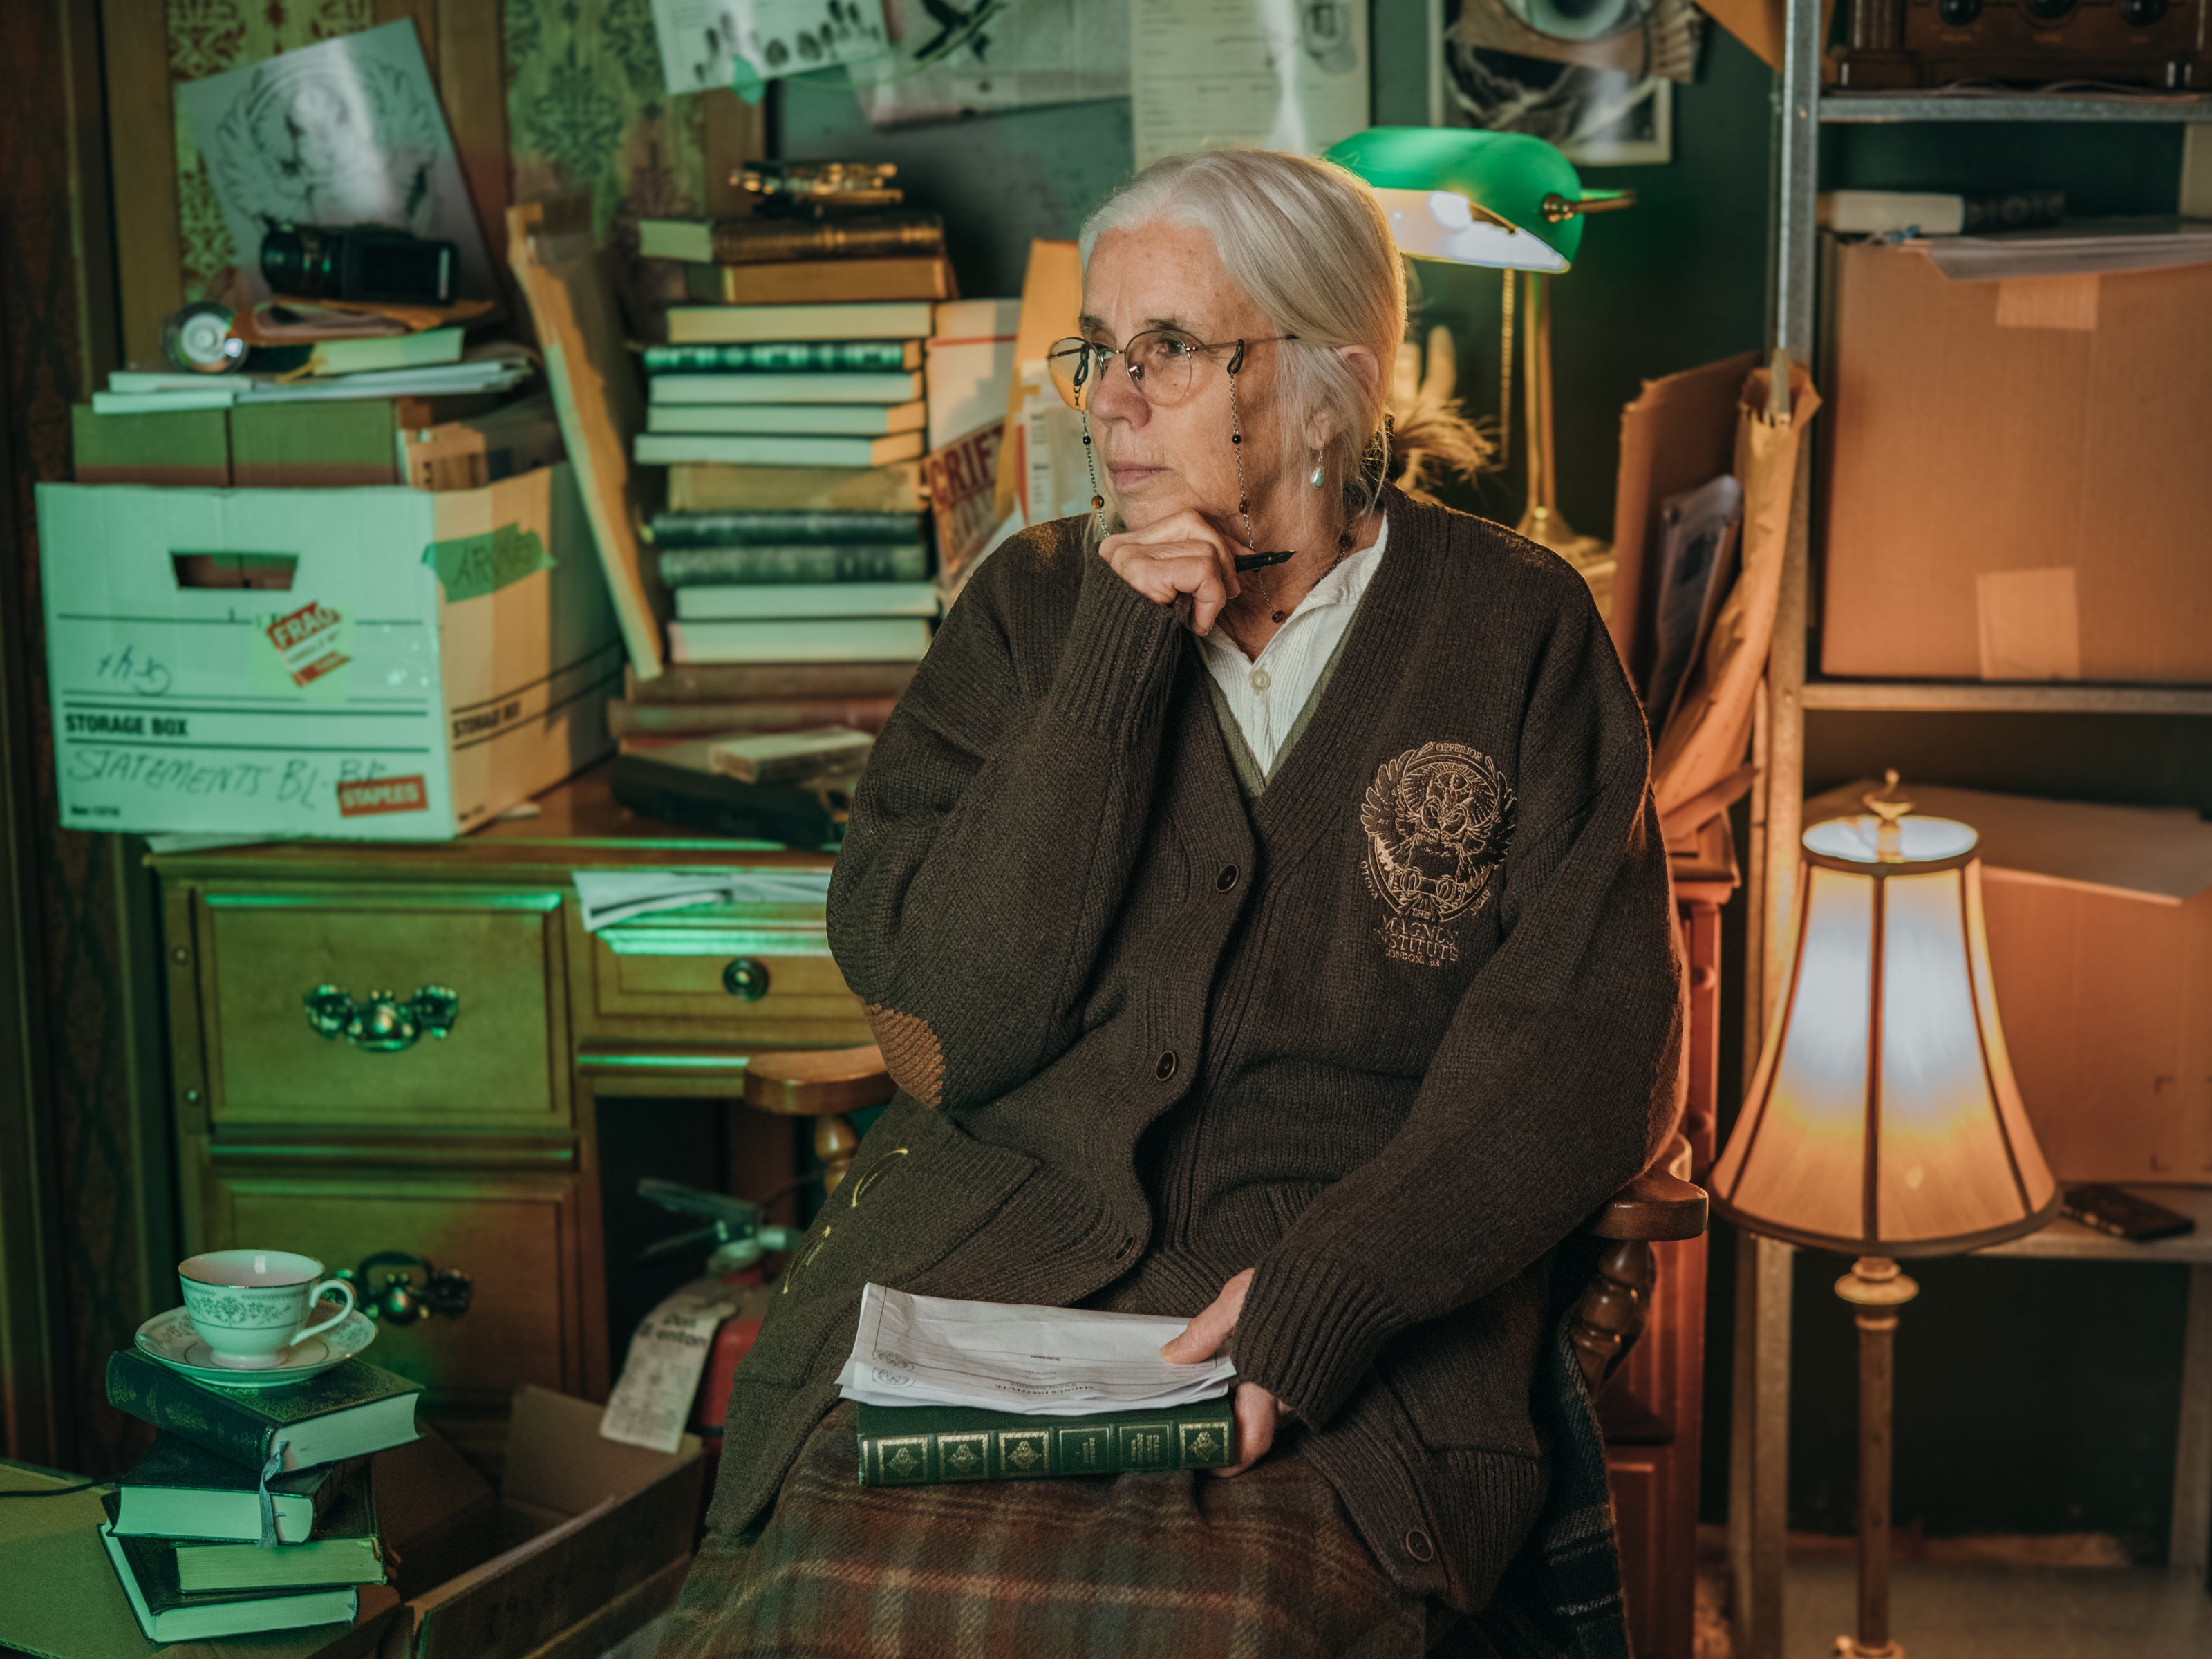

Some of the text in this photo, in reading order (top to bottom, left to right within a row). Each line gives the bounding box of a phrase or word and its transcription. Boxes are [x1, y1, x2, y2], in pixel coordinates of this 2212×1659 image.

[66, 714, 189, 737] STORAGE BOX
[1436, 742, 1483, 762] OPPERIOR
[67, 748, 272, 796] STATEMENTS
[341, 782, 419, 809] STAPLES
[995, 1383, 1094, 1396] MAGNUS INSTITUTE
